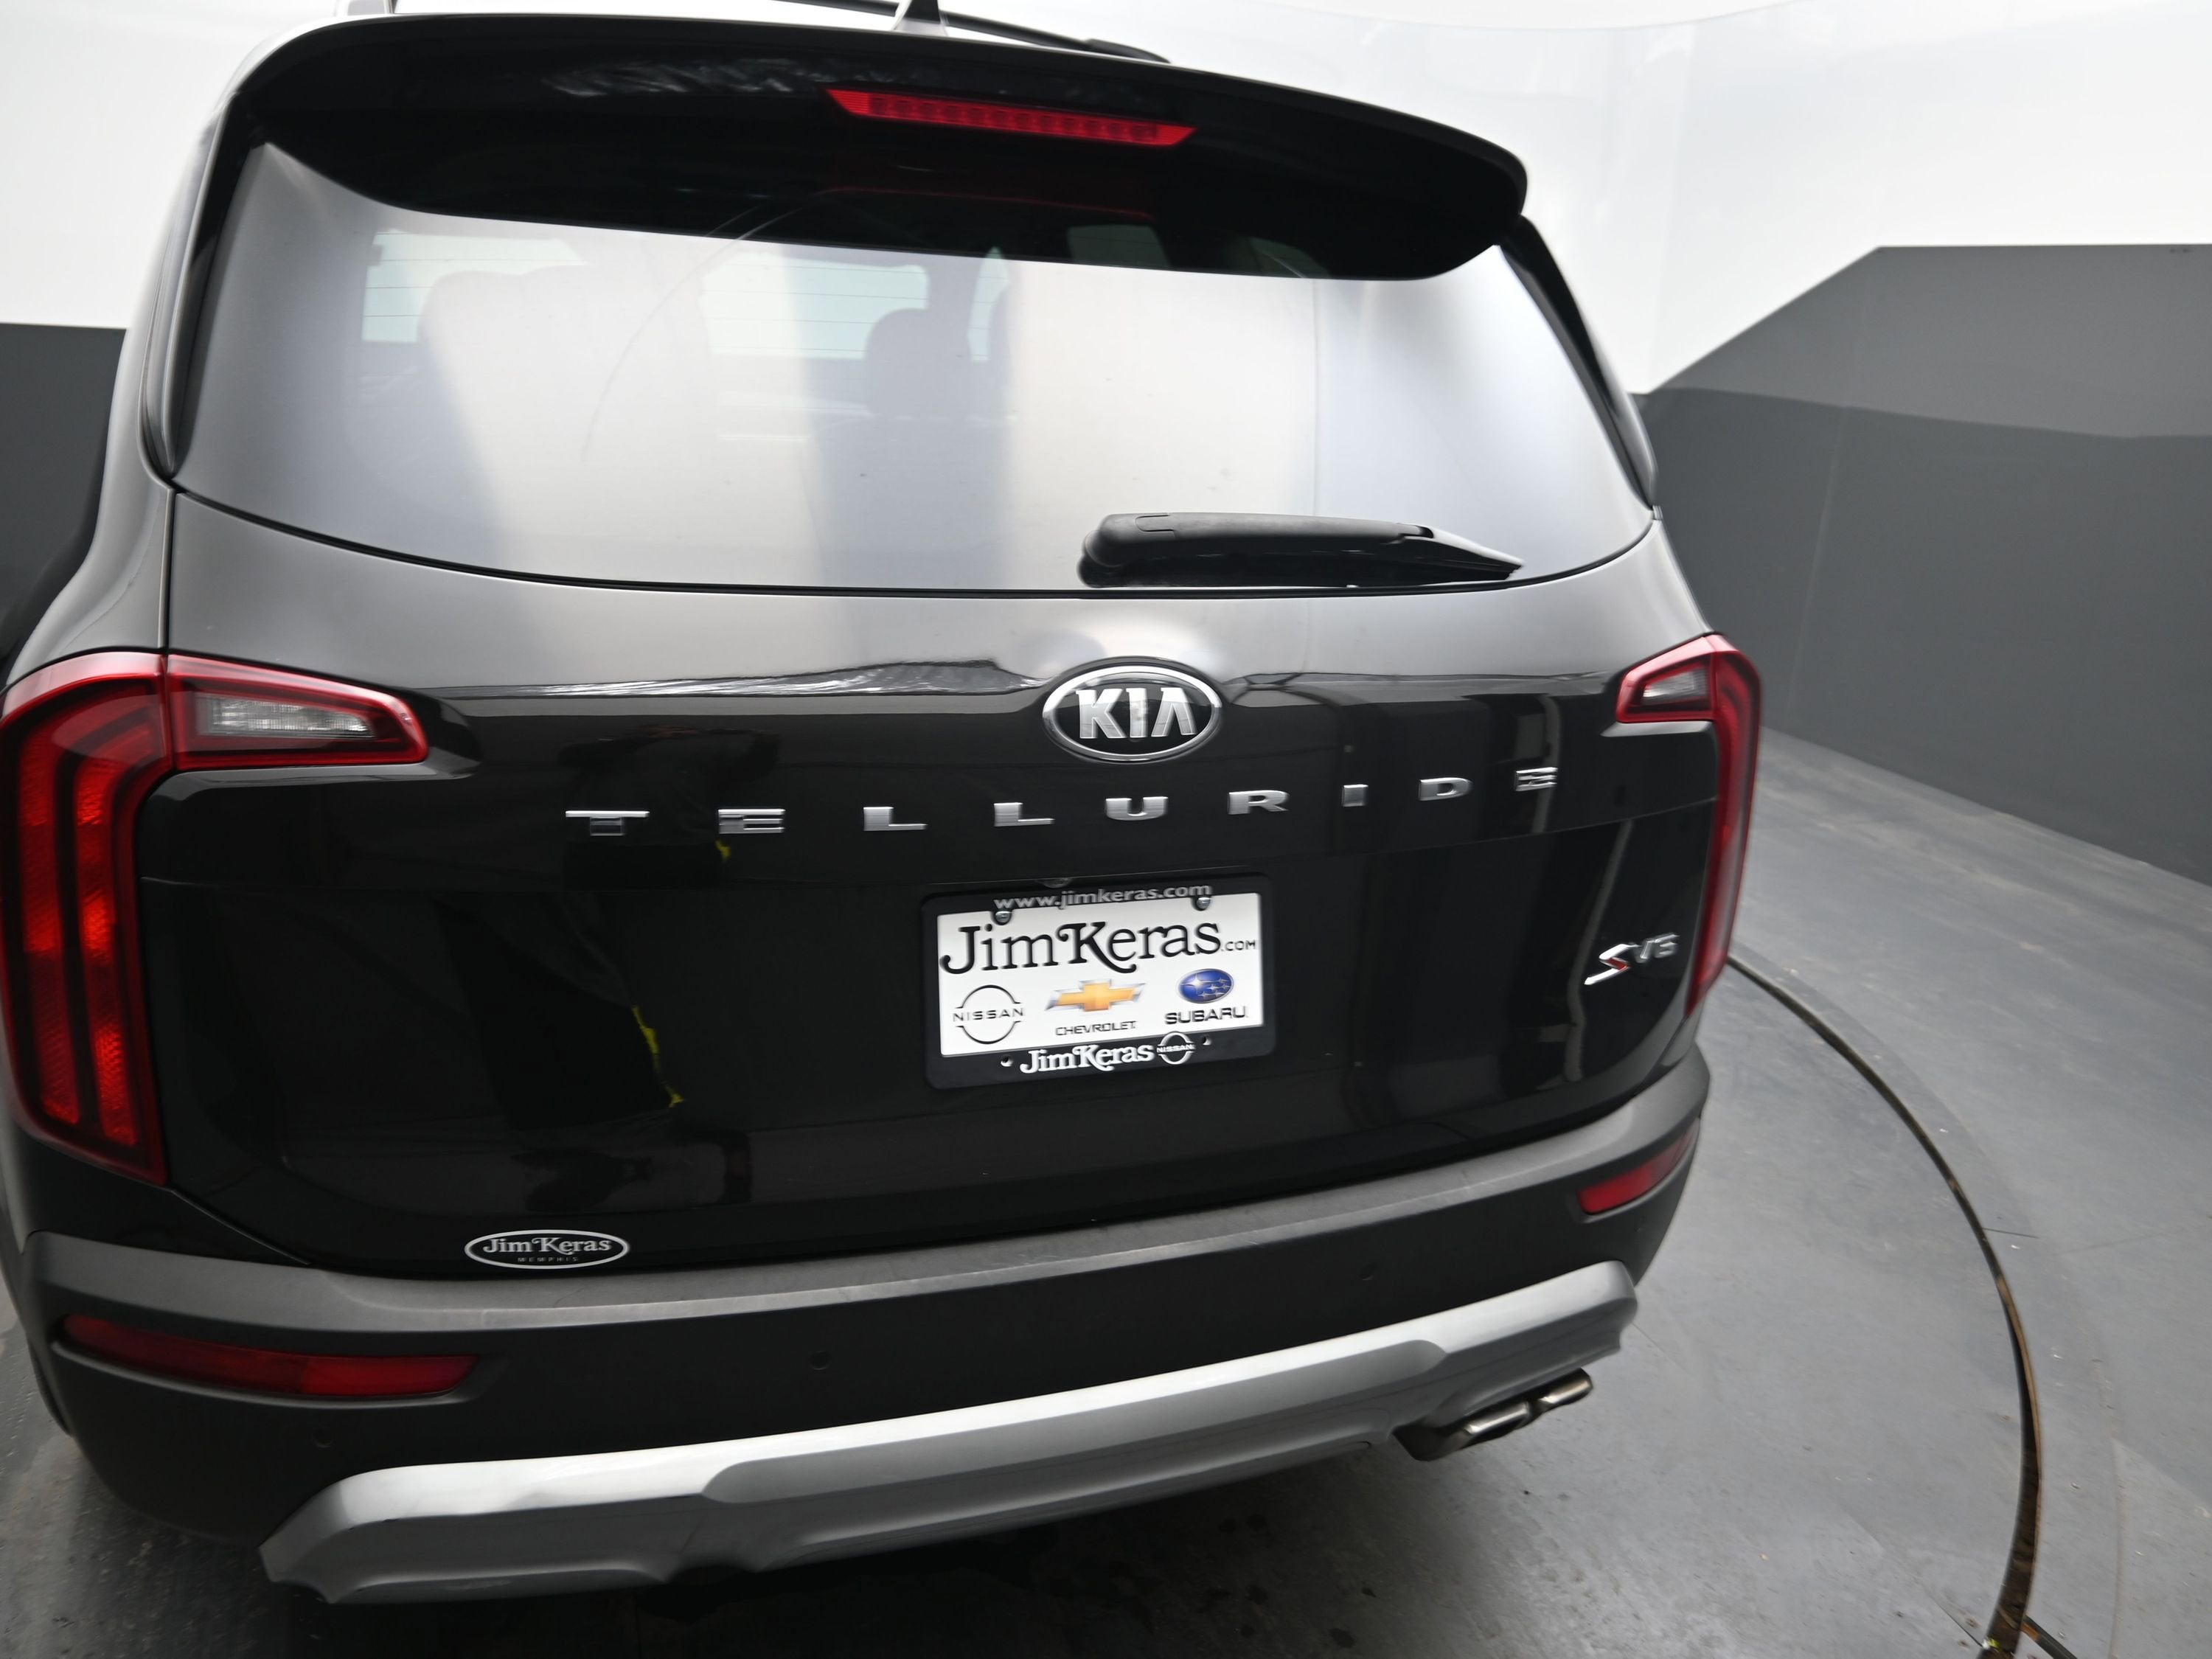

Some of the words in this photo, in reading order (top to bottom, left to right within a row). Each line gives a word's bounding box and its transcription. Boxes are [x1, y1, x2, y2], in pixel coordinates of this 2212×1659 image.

[1075, 686, 1197, 739] KIA
[565, 767, 1559, 836] TELLURIDE
[993, 885, 1211, 910] www.jimkeras.com
[953, 1007, 1023, 1022] NISSAN
[1164, 1006, 1246, 1025] SUBARU
[1055, 1020, 1136, 1036] CHEVROLET
